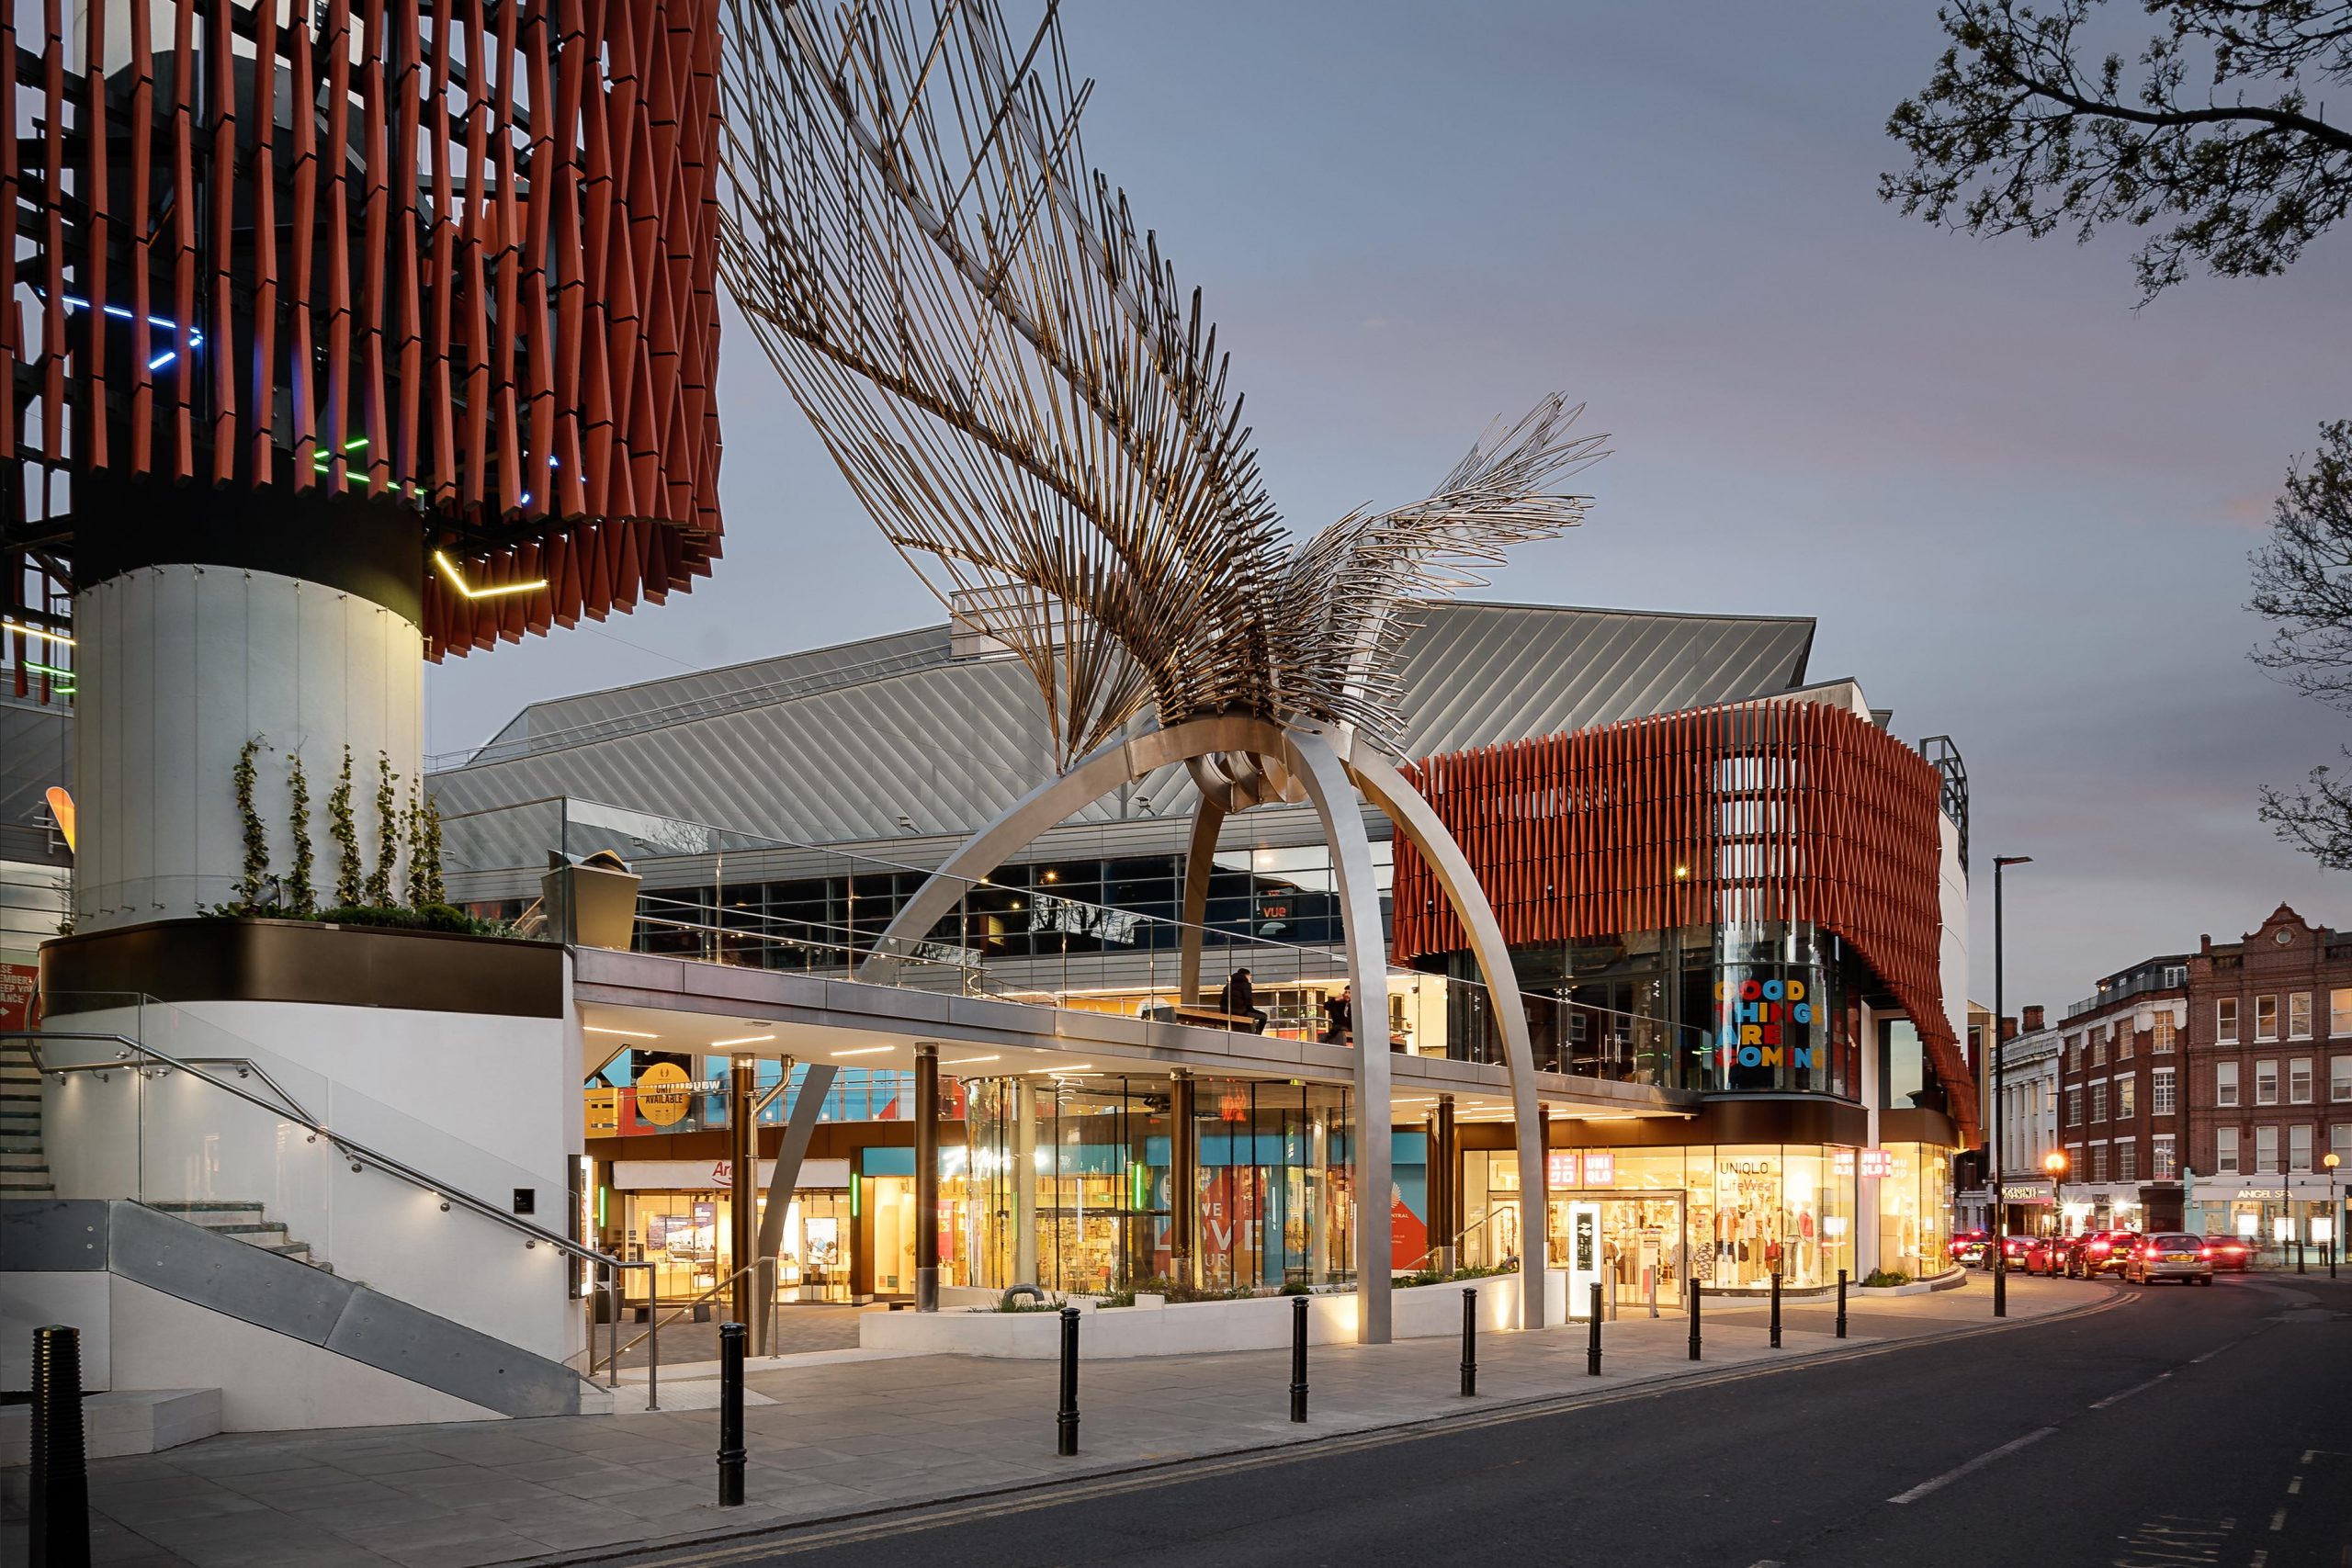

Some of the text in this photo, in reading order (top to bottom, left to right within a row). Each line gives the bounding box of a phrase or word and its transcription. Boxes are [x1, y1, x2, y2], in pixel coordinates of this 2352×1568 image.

[1714, 979, 1804, 1001] GOOD
[1714, 1002, 1823, 1026] THINGS
[1715, 1024, 1782, 1045] ARE
[1715, 1046, 1824, 1069] COMING
[645, 1094, 684, 1104] AVAILABLE
[1586, 1157, 1610, 1169] UNI
[1720, 1162, 1769, 1176] UNIQLO
[1586, 1170, 1611, 1184] QLO
[2237, 1190, 2272, 1199] ANGEL
[1154, 1220, 1262, 1250] LVE
